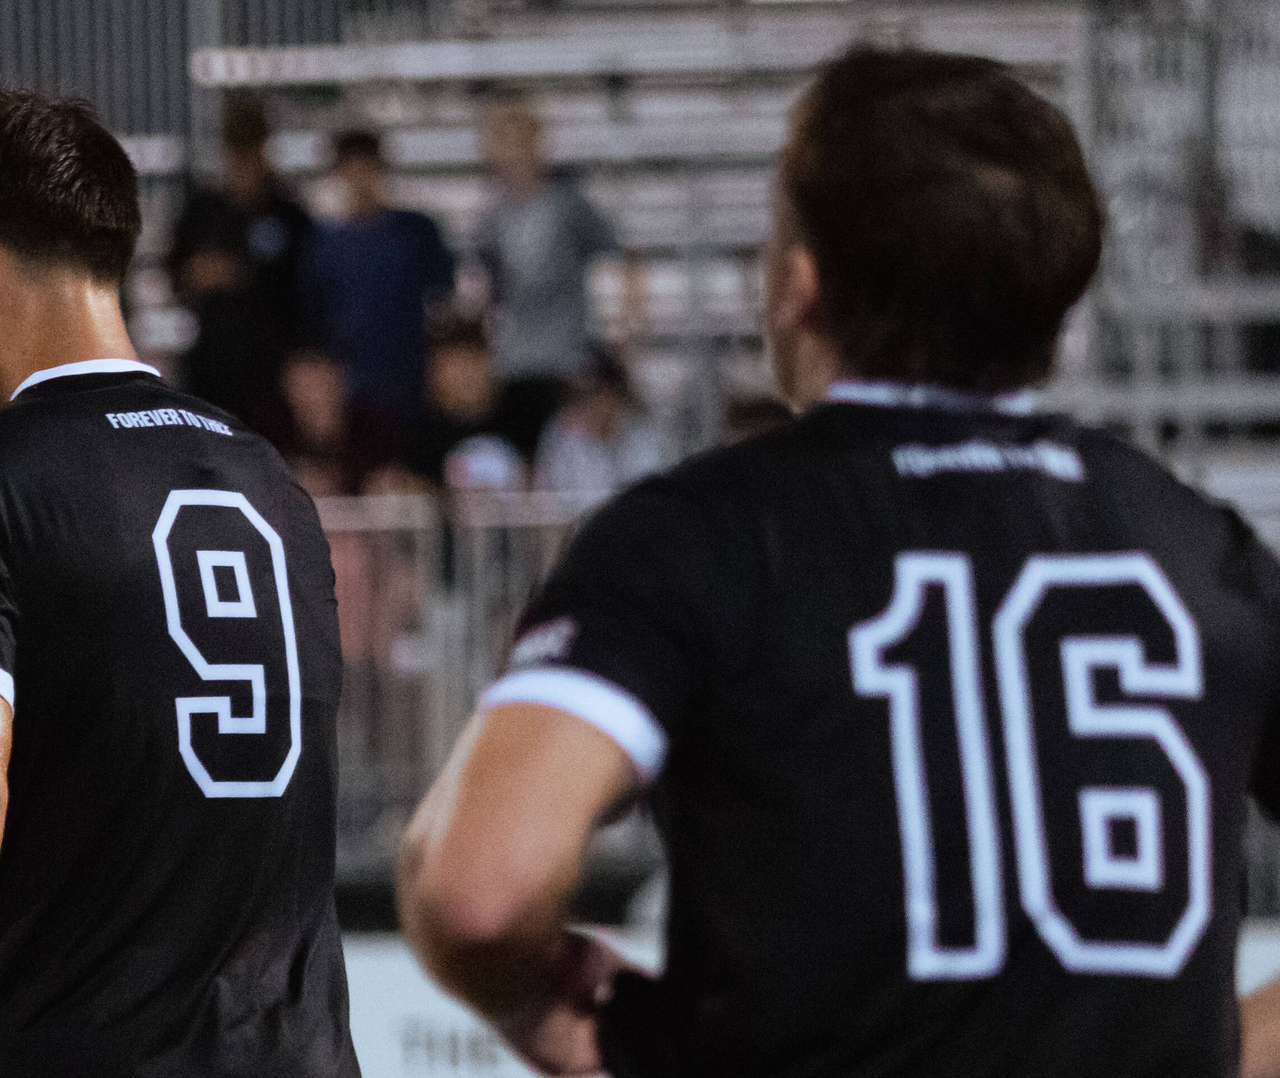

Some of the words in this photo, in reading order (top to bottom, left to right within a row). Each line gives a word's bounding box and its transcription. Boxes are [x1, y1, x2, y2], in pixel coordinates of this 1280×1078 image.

[105, 408, 184, 429] FOREVER
[178, 409, 202, 428] TO
[152, 488, 302, 798] 9
[848, 550, 1212, 980] 16
